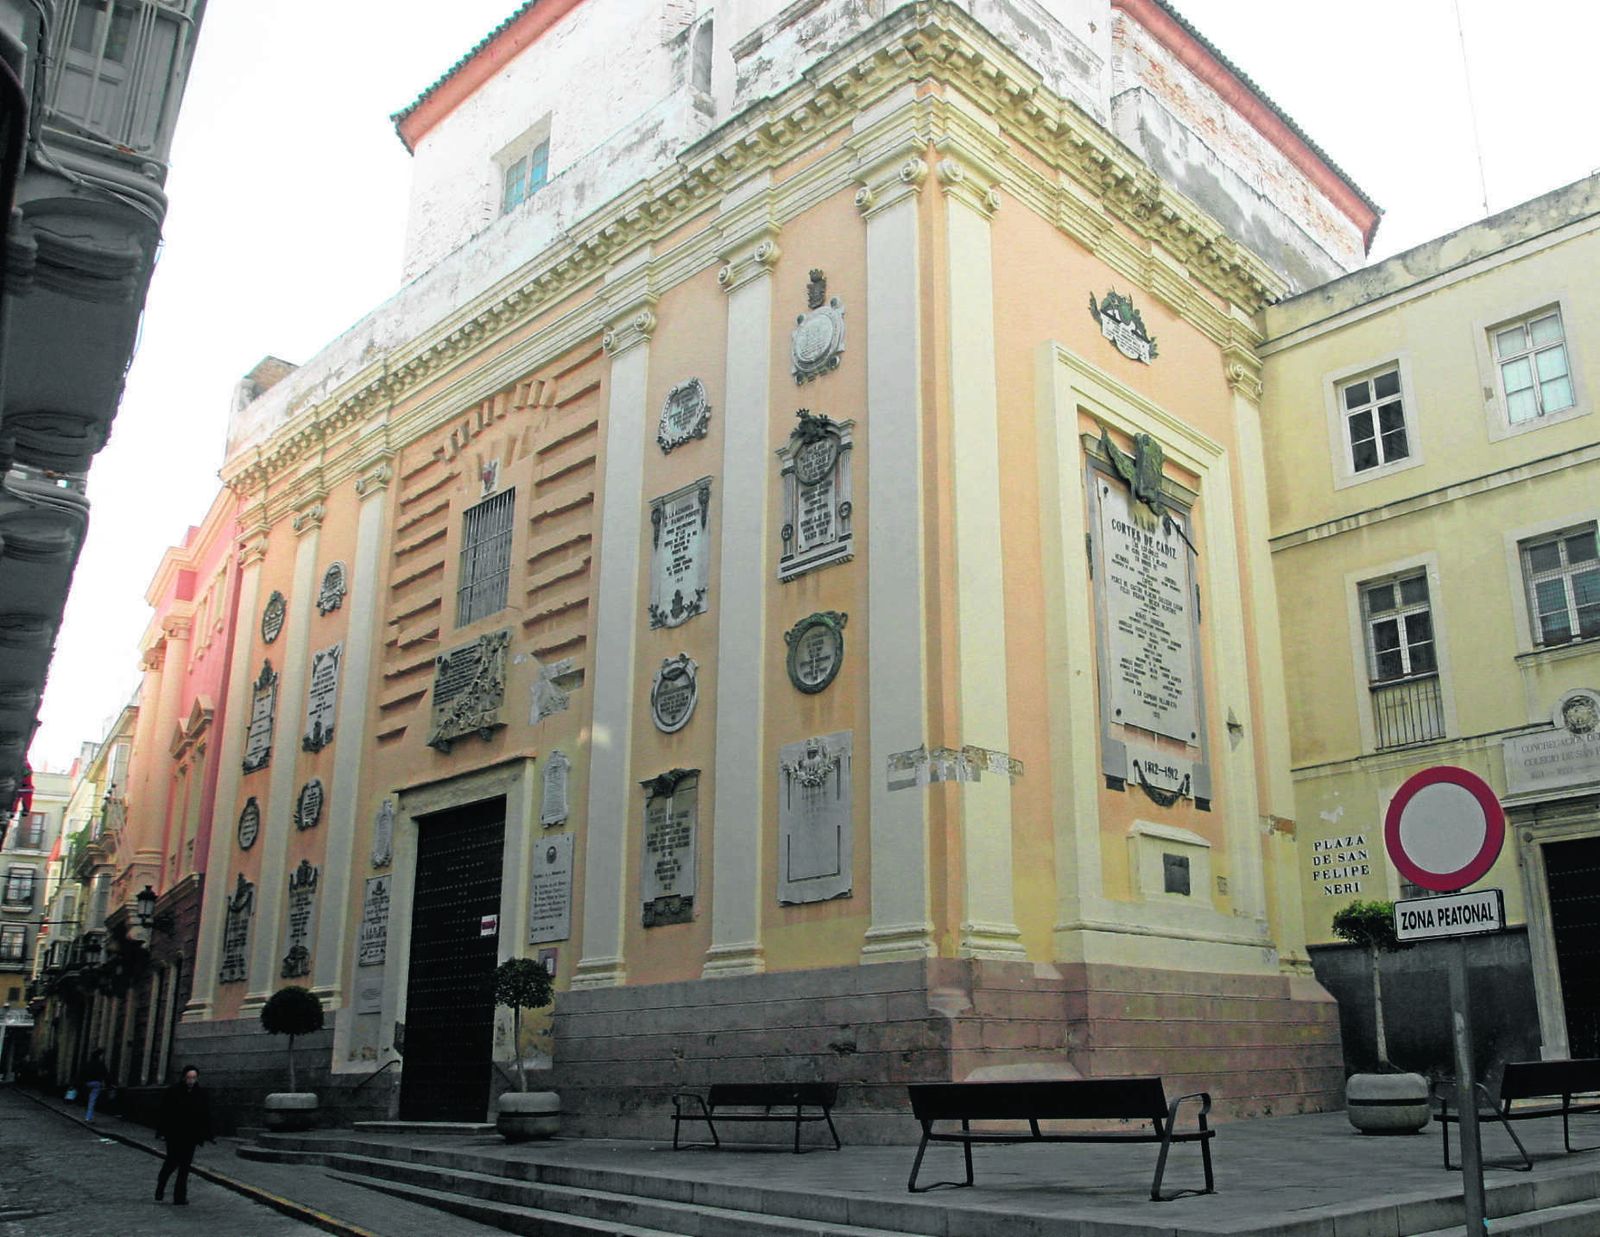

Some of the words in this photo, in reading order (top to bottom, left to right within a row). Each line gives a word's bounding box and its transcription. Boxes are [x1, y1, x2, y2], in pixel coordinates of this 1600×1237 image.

[1111, 518, 1141, 542] CORTES
[1143, 533, 1153, 547] DE
[1156, 540, 1177, 560] CADIZ
[1314, 835, 1364, 851] PLAZA
[1313, 854, 1331, 866] DE
[1338, 850, 1367, 863] SAN
[1313, 864, 1369, 881] FELIPE
[1324, 882, 1359, 895] NERI
[1401, 909, 1435, 931] ZONA
[1437, 902, 1494, 927] PEATONAL
